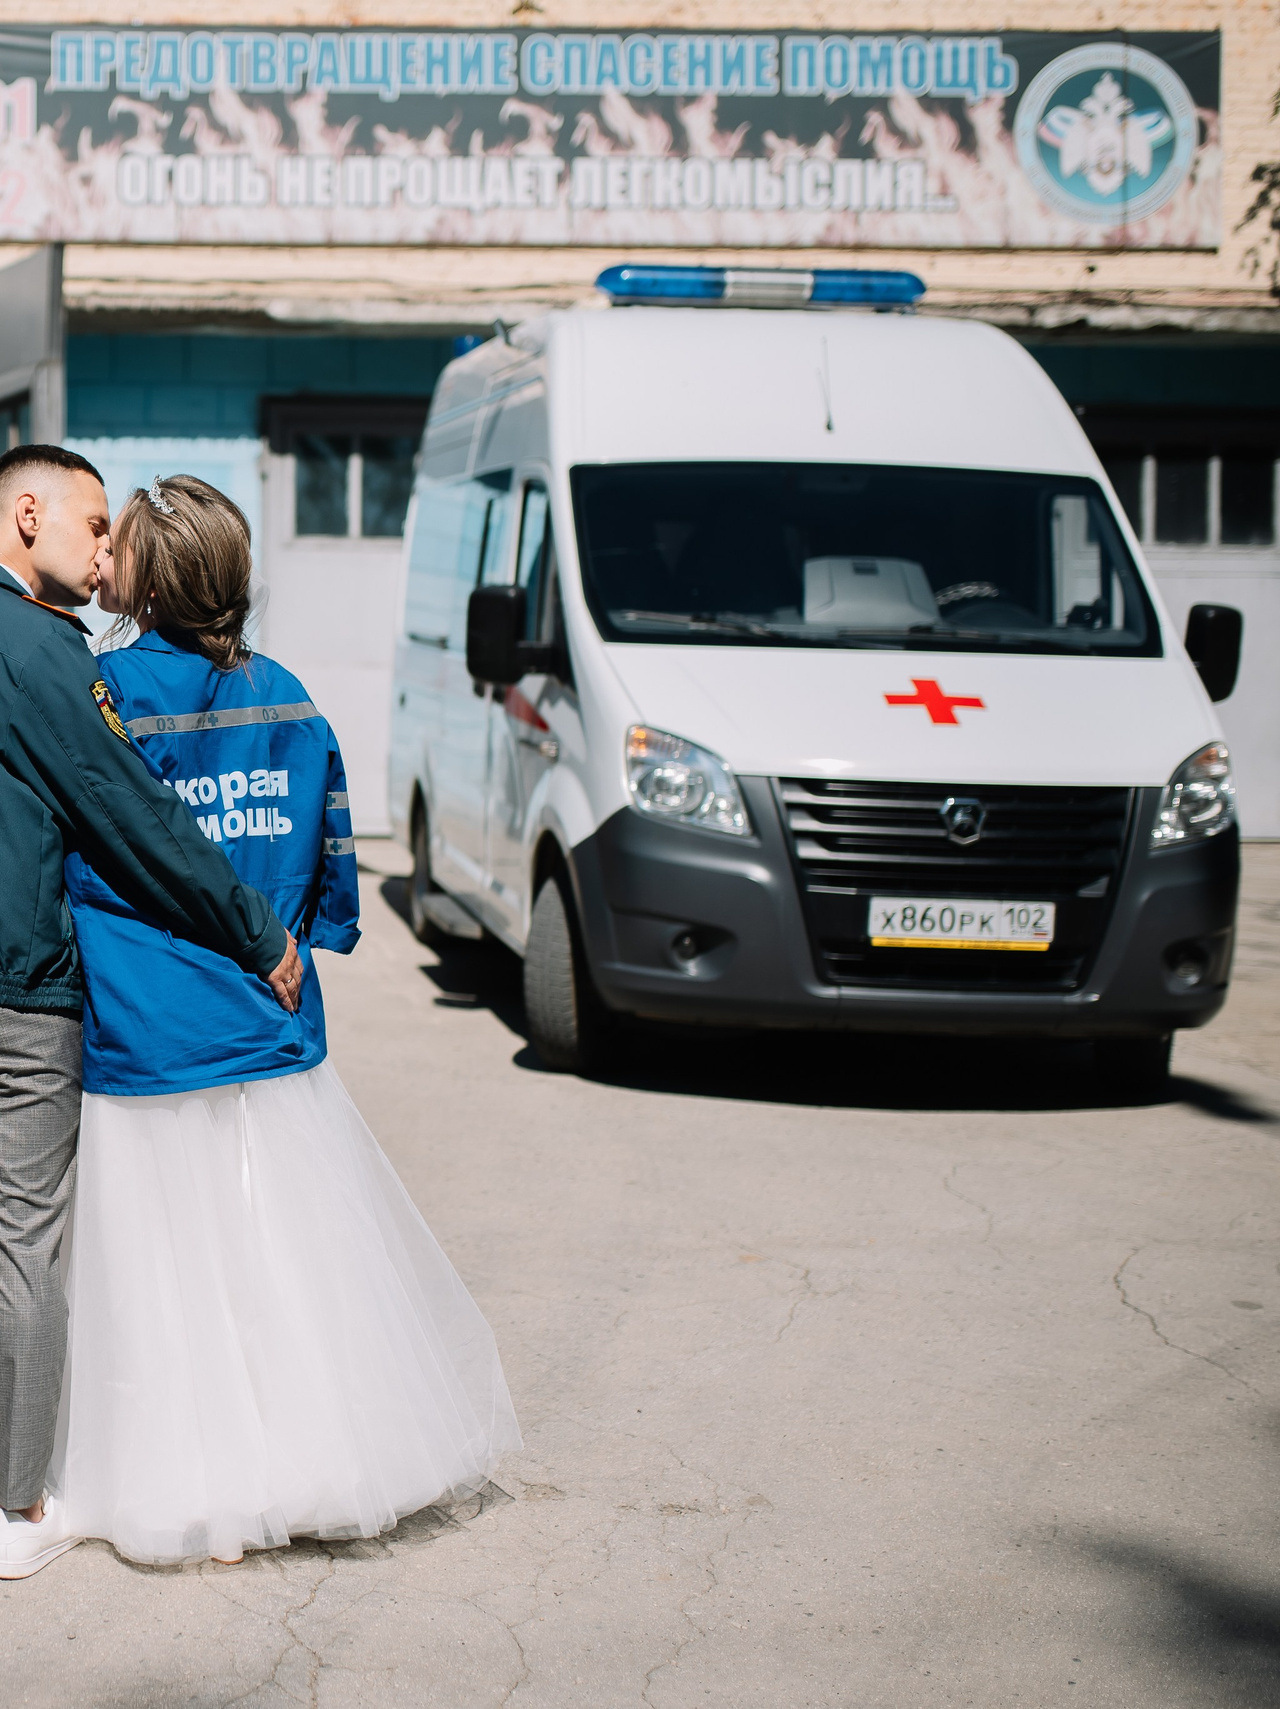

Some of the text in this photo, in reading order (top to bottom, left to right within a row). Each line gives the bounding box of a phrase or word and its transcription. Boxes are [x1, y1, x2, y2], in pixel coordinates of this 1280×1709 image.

[53, 32, 1017, 101] ПРЕДОТВРАЩЕНИЕ СПАСЕНИЕ ПОМОЩЬ
[120, 155, 269, 206] ОГОНЬ
[277, 156, 337, 206] НЕ
[342, 157, 563, 213] ПРОЩАЕТ
[157, 708, 279, 732] 03 03
[163, 769, 289, 810] корая
[196, 807, 293, 842] мощь
[1004, 907, 1046, 929] 102
